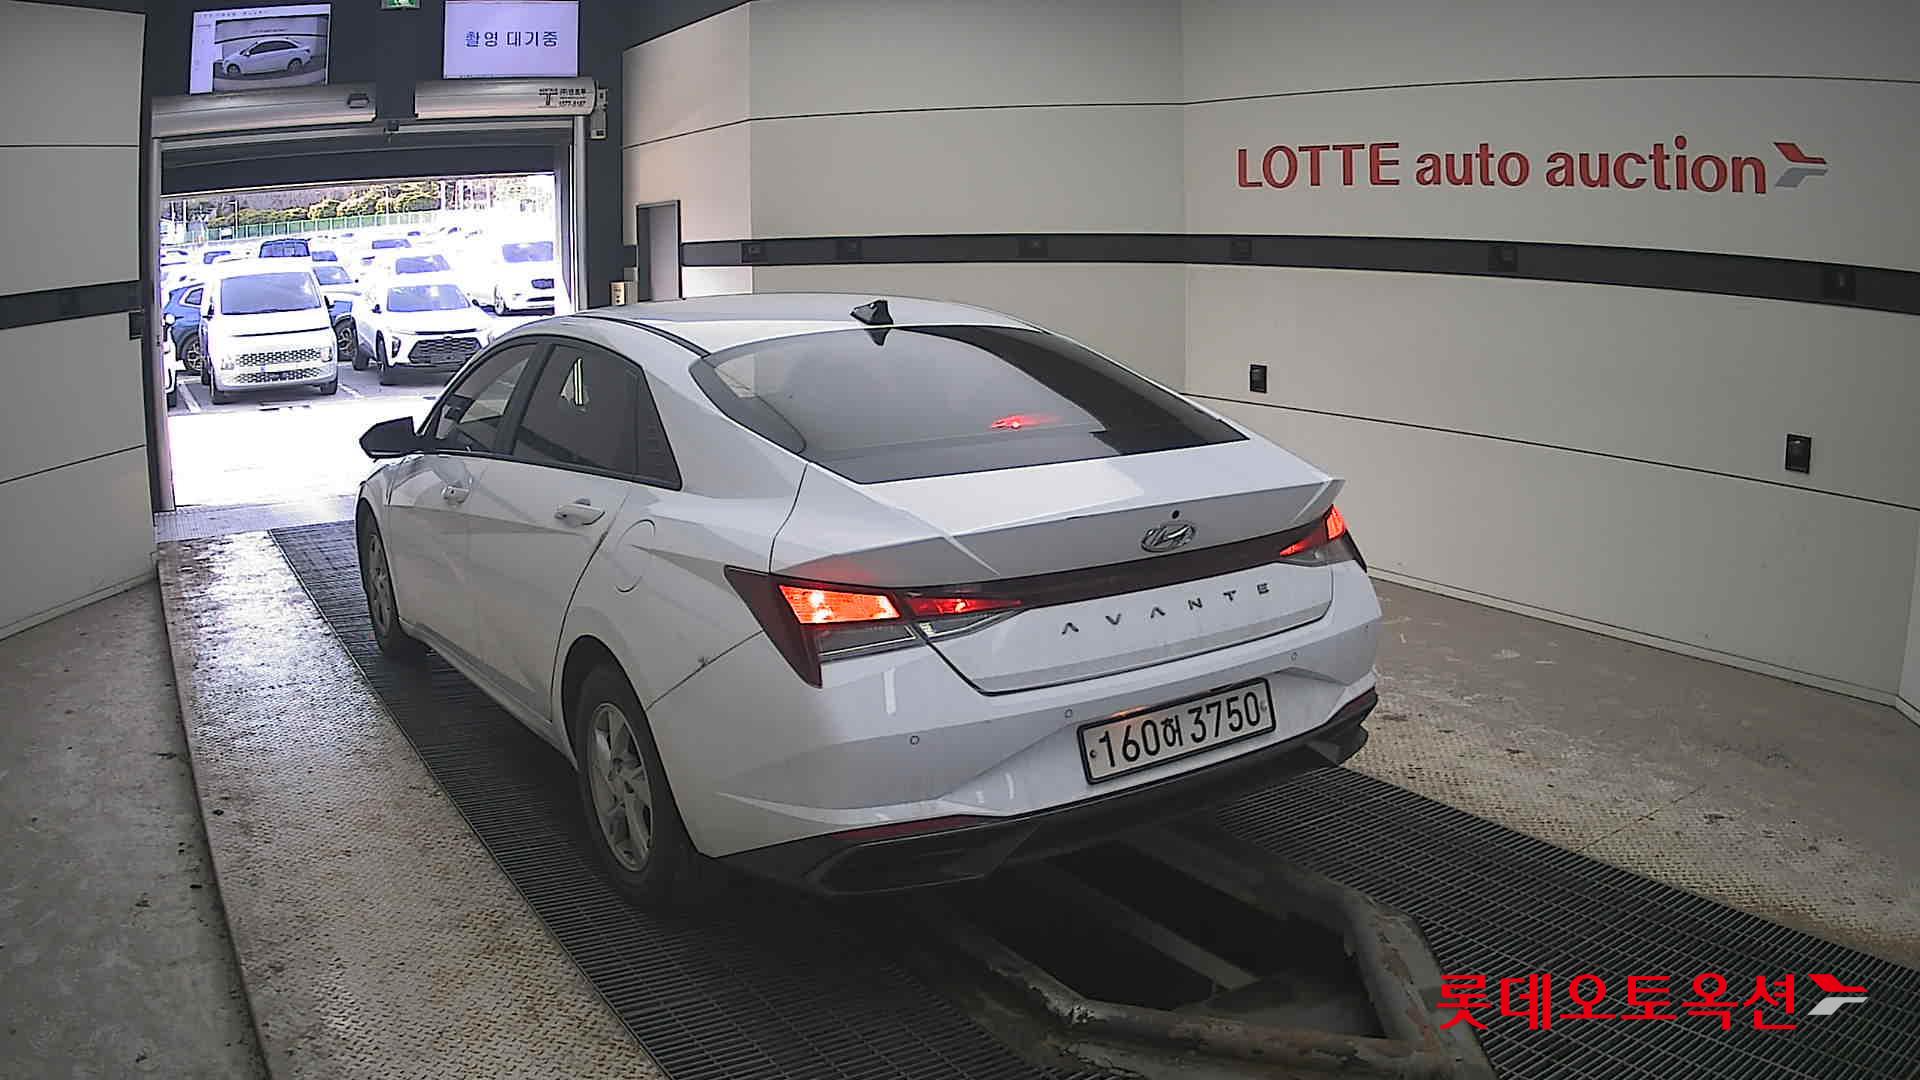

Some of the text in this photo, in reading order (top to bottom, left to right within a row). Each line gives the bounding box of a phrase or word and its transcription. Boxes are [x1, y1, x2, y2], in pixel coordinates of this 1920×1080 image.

[465, 30, 559, 48] 촬영 대기중
[1239, 136, 1766, 193] LOTTE auto auction
[1061, 582, 1270, 635] AVANTE
